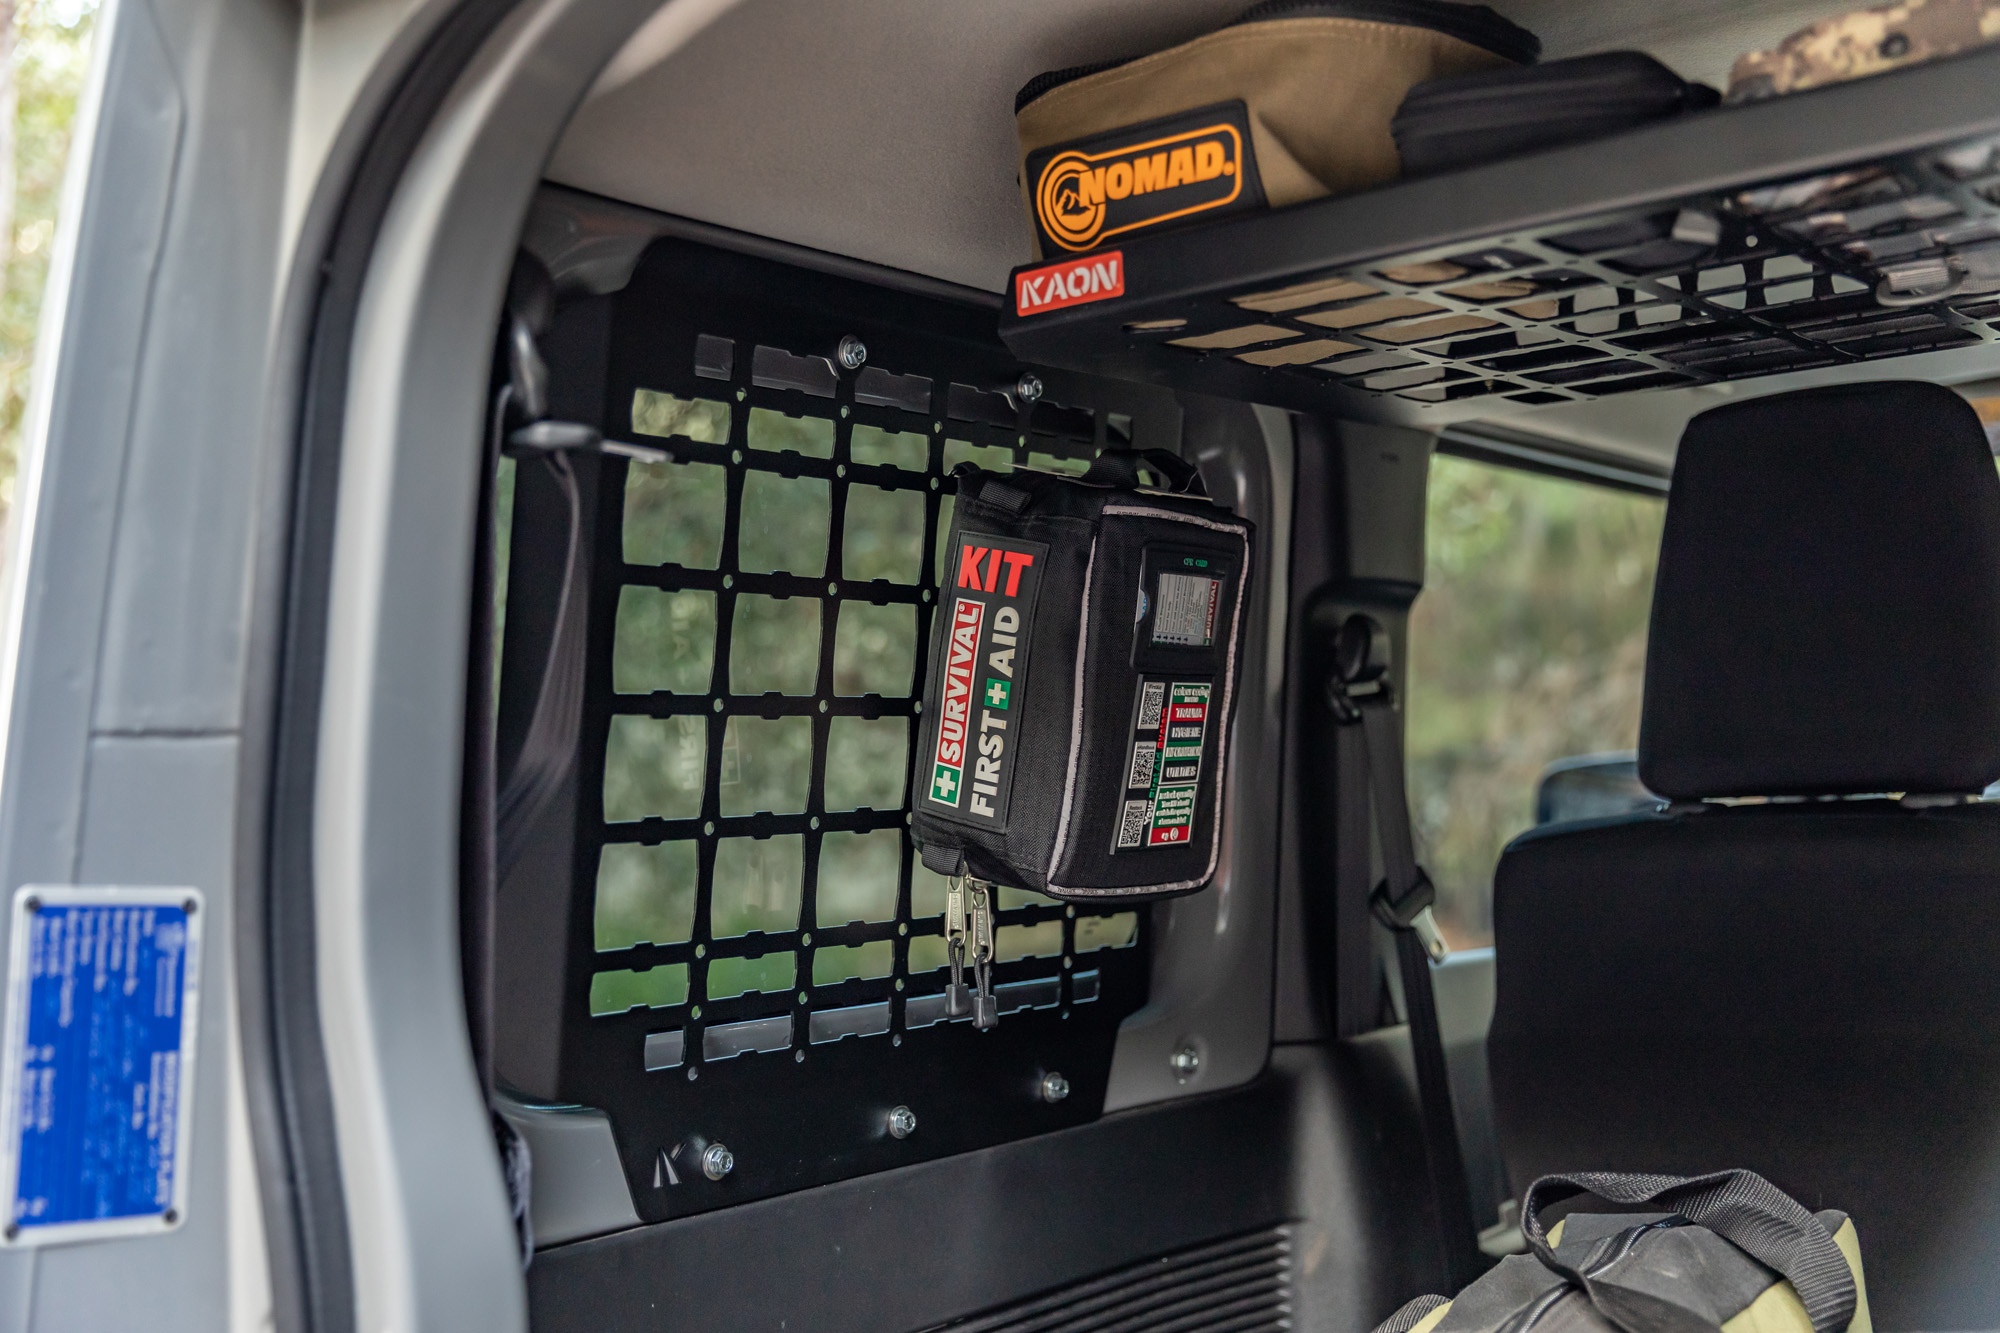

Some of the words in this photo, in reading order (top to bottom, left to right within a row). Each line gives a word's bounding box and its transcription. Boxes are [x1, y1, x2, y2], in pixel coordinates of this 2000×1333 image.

[1020, 259, 1118, 309] KAON
[957, 545, 1034, 597] KIT
[969, 709, 1007, 818] FIRST
[988, 606, 1020, 679] AID
[1171, 727, 1202, 738] HYGIENE
[1176, 707, 1203, 718] TRAUMA
